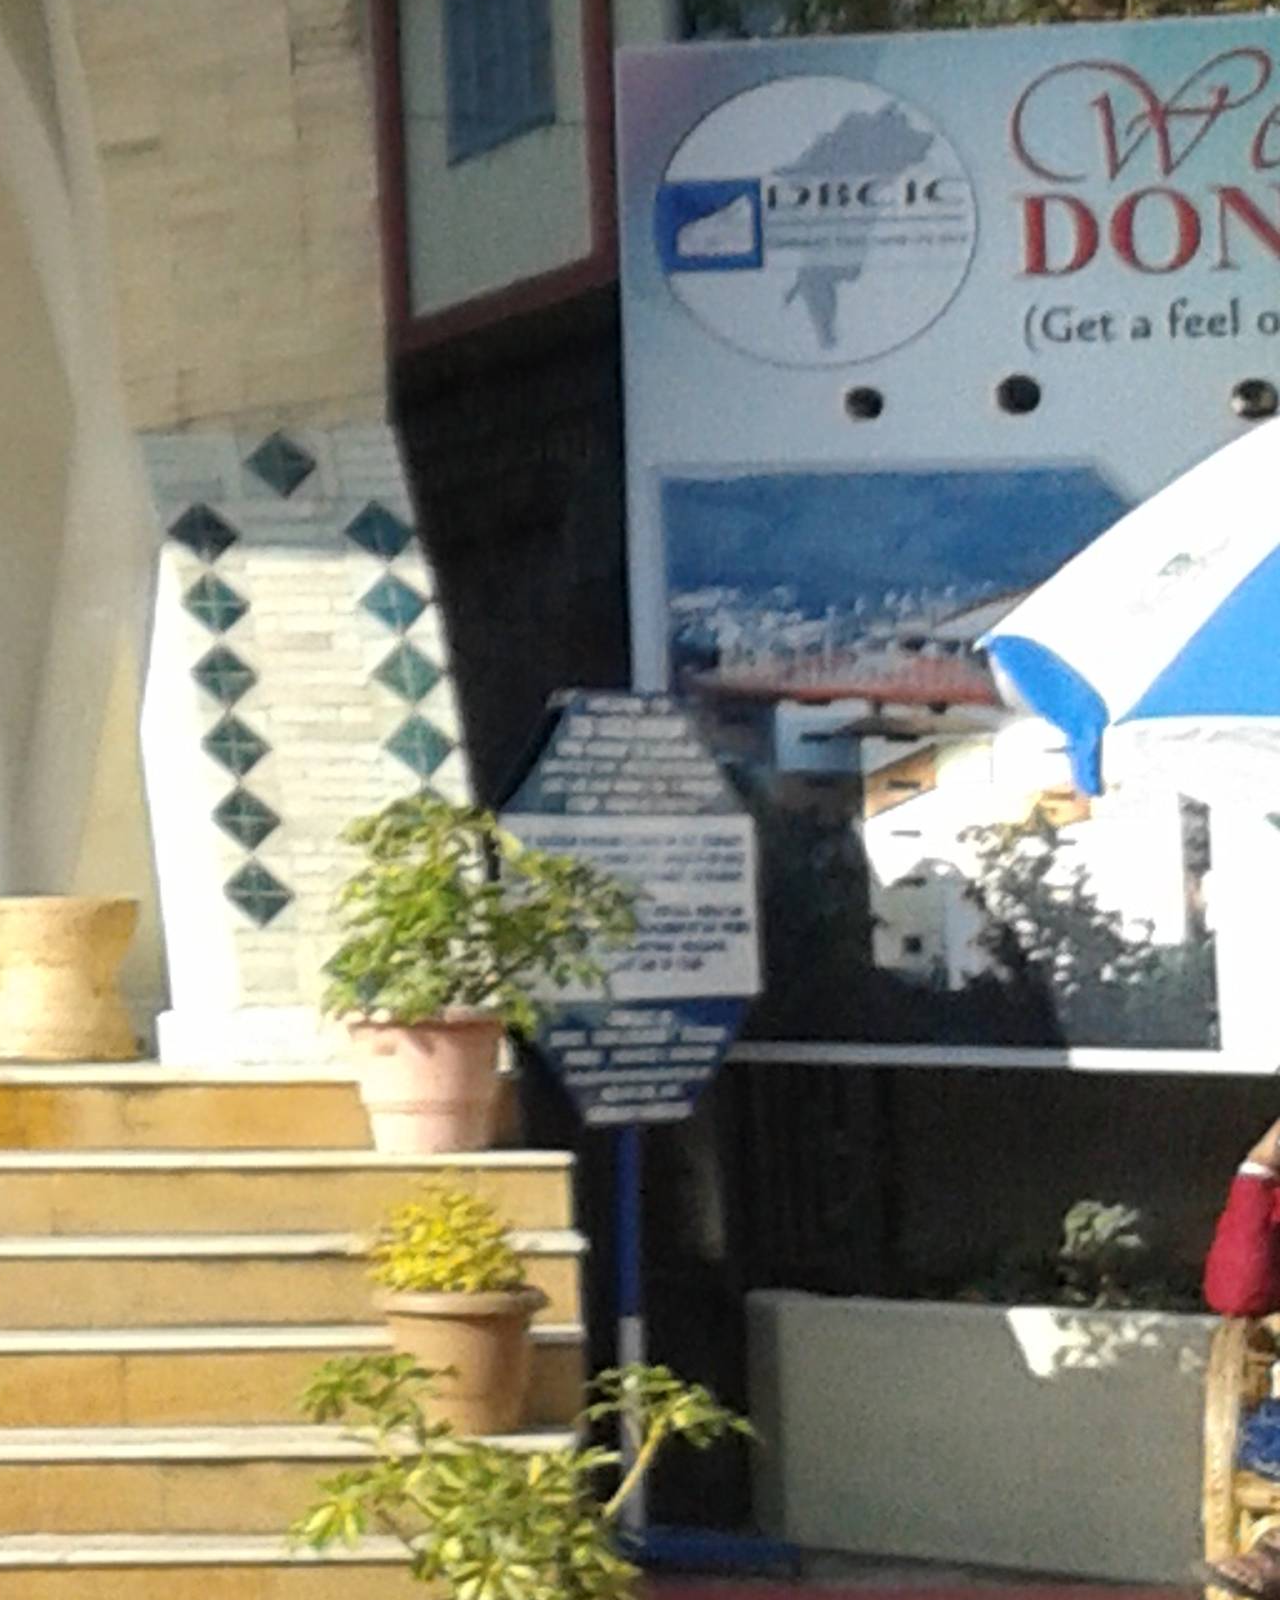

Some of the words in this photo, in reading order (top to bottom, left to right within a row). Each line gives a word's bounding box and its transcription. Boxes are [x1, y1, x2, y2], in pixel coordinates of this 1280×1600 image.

[1014, 182, 1280, 279] DON
[1023, 303, 1115, 352] (Get
[1129, 314, 1152, 340] a
[1167, 297, 1242, 340] feel
